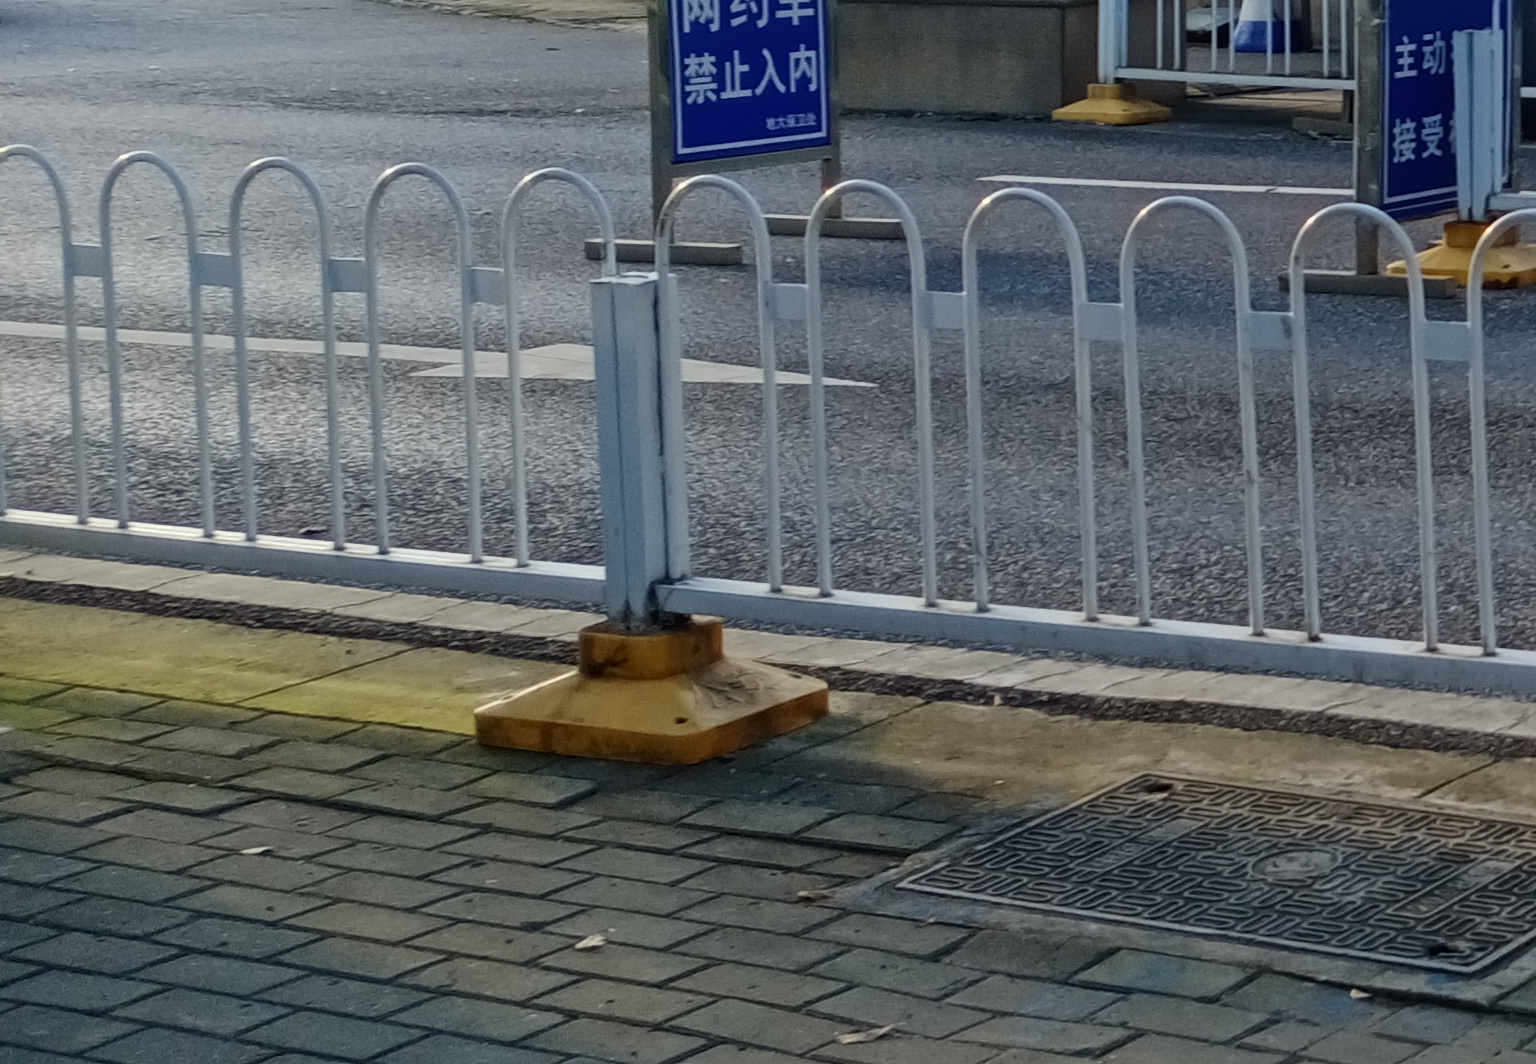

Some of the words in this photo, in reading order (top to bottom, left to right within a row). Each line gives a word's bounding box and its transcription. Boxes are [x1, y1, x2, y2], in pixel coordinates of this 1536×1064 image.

[683, 43, 819, 105] 禁止入内
[1393, 31, 1454, 79] 主动
[1392, 112, 1456, 164] 接受
